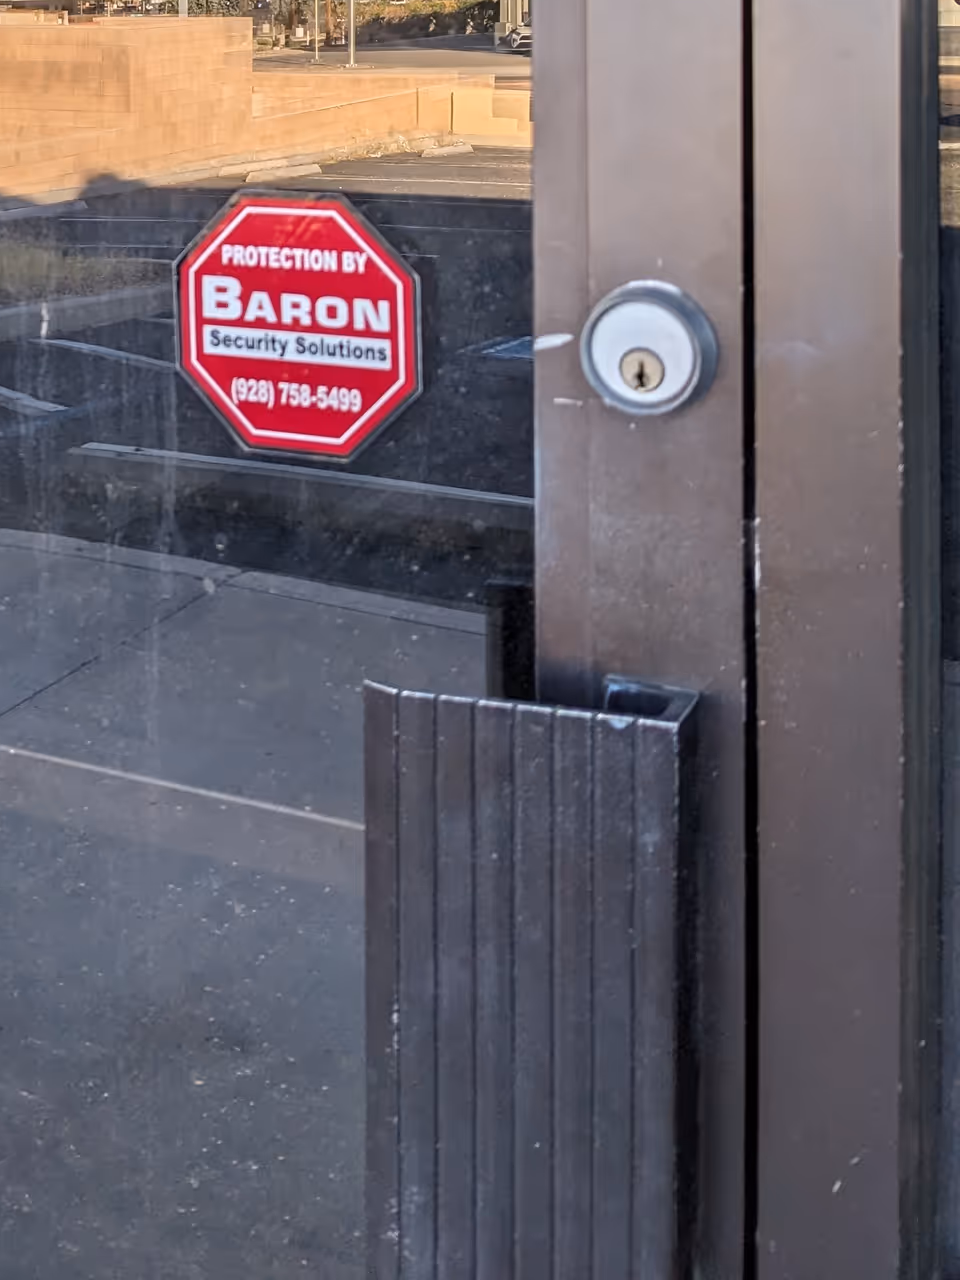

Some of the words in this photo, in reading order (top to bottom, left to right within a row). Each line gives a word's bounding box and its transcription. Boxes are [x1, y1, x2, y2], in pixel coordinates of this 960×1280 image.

[222, 244, 338, 271] PROTECTION
[341, 251, 368, 273] BY
[210, 329, 288, 357] Security
[296, 336, 387, 362] Solutions
[230, 377, 275, 408] (928)
[278, 381, 362, 413] 758-5499
